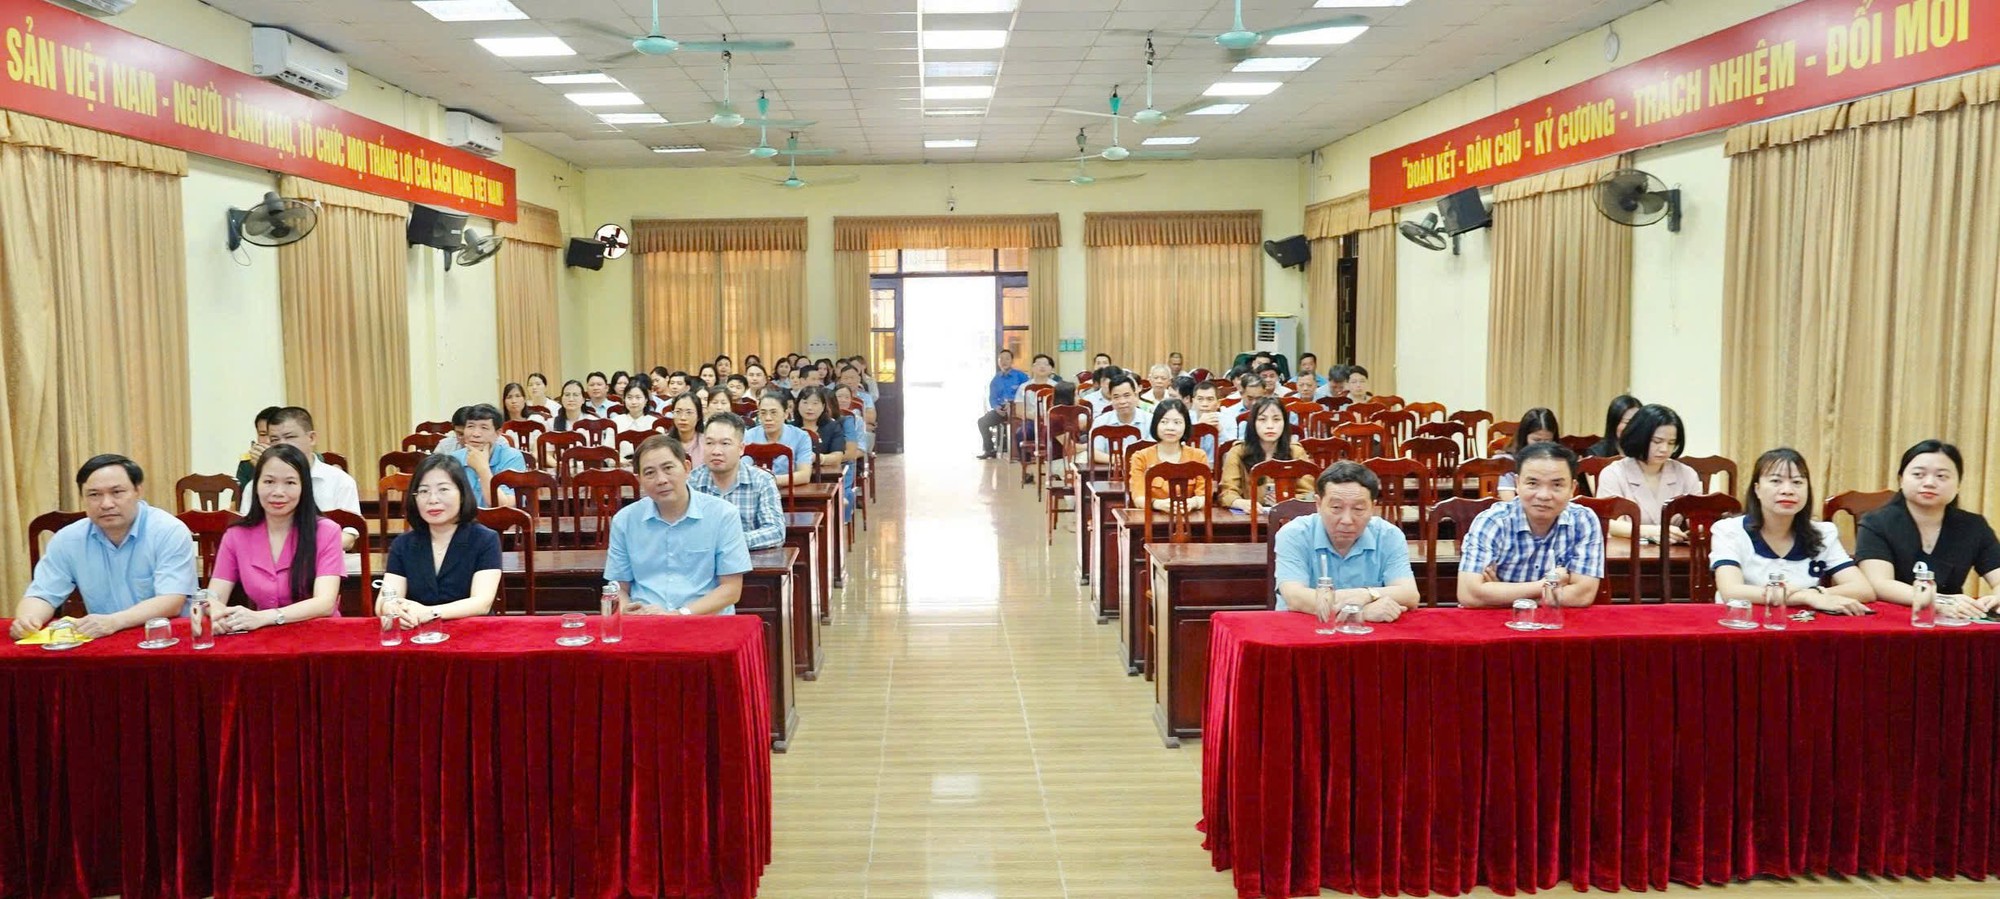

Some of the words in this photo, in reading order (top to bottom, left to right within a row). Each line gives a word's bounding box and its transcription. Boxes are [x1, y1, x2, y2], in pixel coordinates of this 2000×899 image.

[6, 16, 57, 91] SẢN
[62, 42, 106, 112] VIỆT
[112, 62, 158, 117] NAM
[173, 80, 223, 135] NGƯỜI
[226, 92, 264, 146] LÃNH
[316, 124, 345, 168] CHỨC
[347, 135, 367, 180] MỌI
[368, 134, 399, 181] THẮNG
[400, 151, 413, 191] LỢI
[414, 148, 432, 190] CỦA
[432, 157, 453, 195] CÁCH
[452, 167, 474, 203] MẠNG
[473, 170, 487, 208] VIỆT
[1436, 141, 1457, 182] KẾT
[1466, 135, 1492, 174] DÂN
[1494, 118, 1522, 166] CHỦ
[1534, 106, 1554, 156] KỶ
[1558, 98, 1616, 150] CƯƠNG
[1633, 70, 1702, 128] TRÁCH
[1708, 38, 1796, 105] NHIỆM
